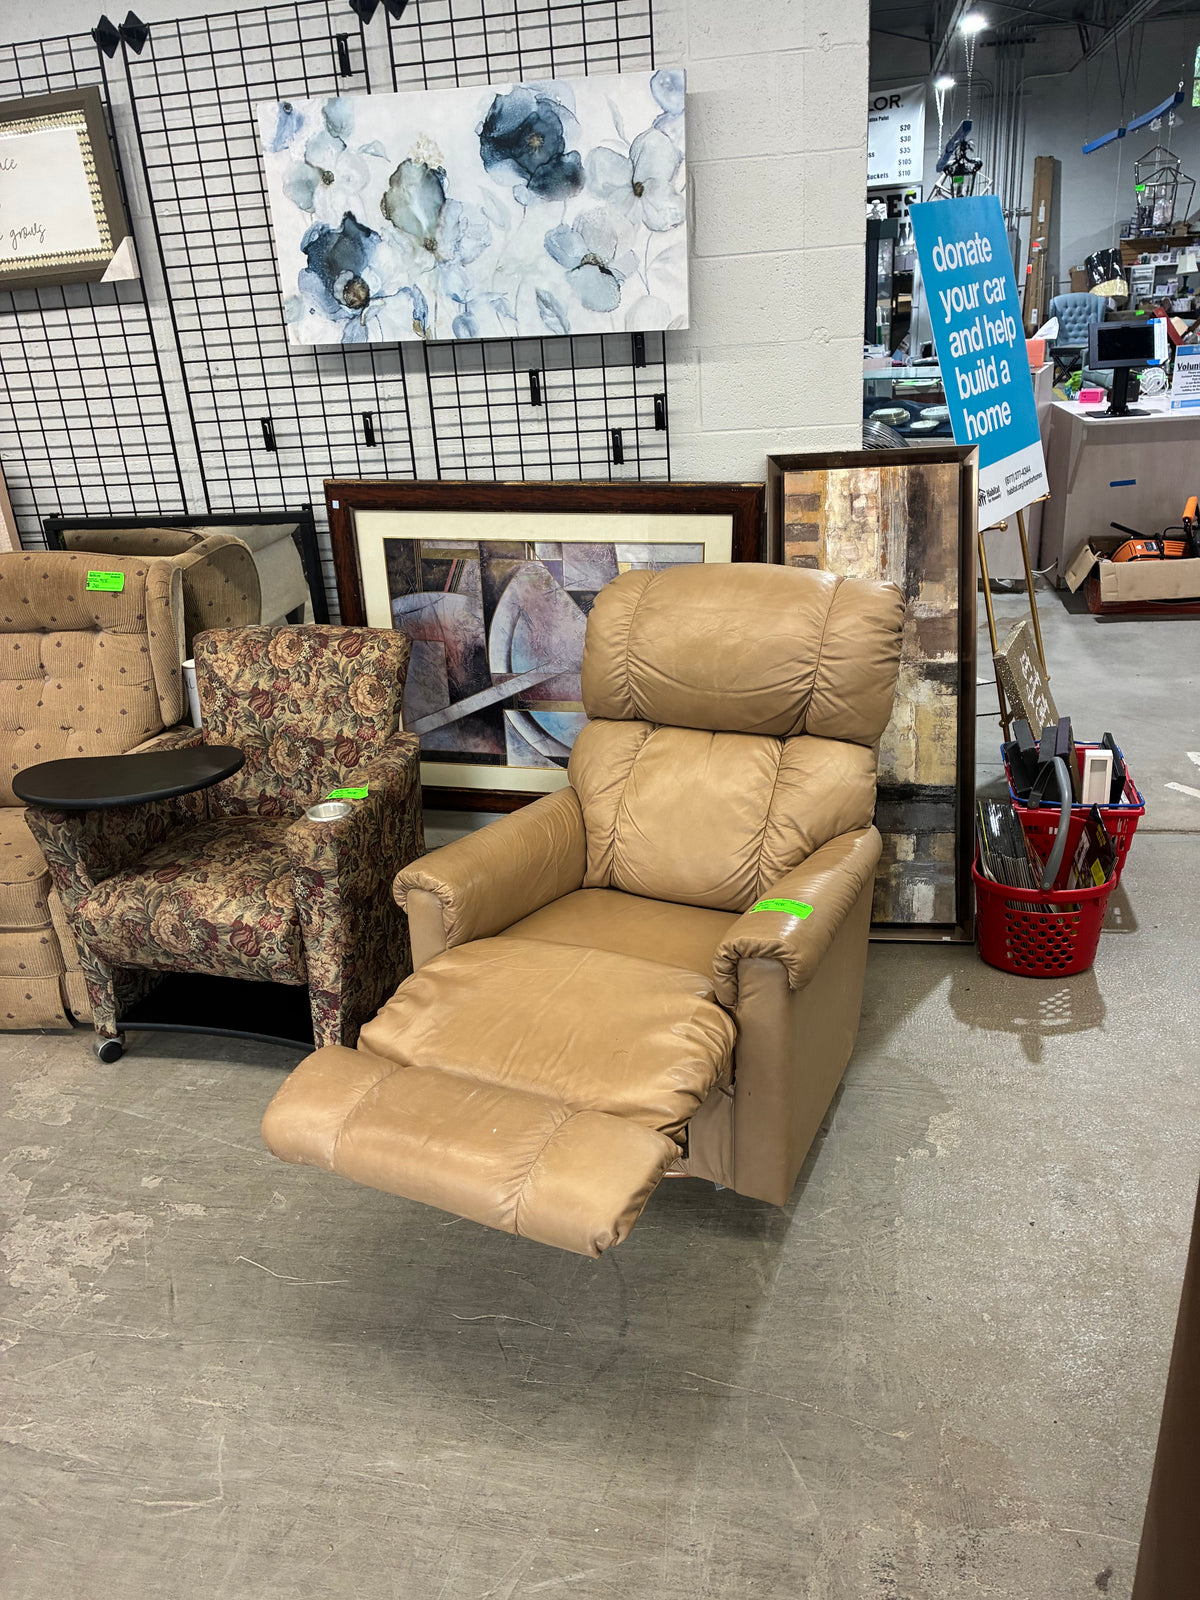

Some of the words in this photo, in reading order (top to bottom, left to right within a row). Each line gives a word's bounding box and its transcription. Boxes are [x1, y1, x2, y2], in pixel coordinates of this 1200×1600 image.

[899, 124, 911, 132] $20
[900, 135, 911, 143] $30
[898, 158, 912, 166] $105
[898, 169, 912, 177] $110
[932, 232, 992, 272] donate
[939, 281, 979, 324] your
[983, 276, 1006, 305] car
[949, 317, 984, 358] and
[983, 310, 1016, 348] help
[955, 355, 999, 400] build
[1000, 359, 1011, 384] a
[963, 401, 1012, 441] home
[986, 485, 1001, 497] Habitat
